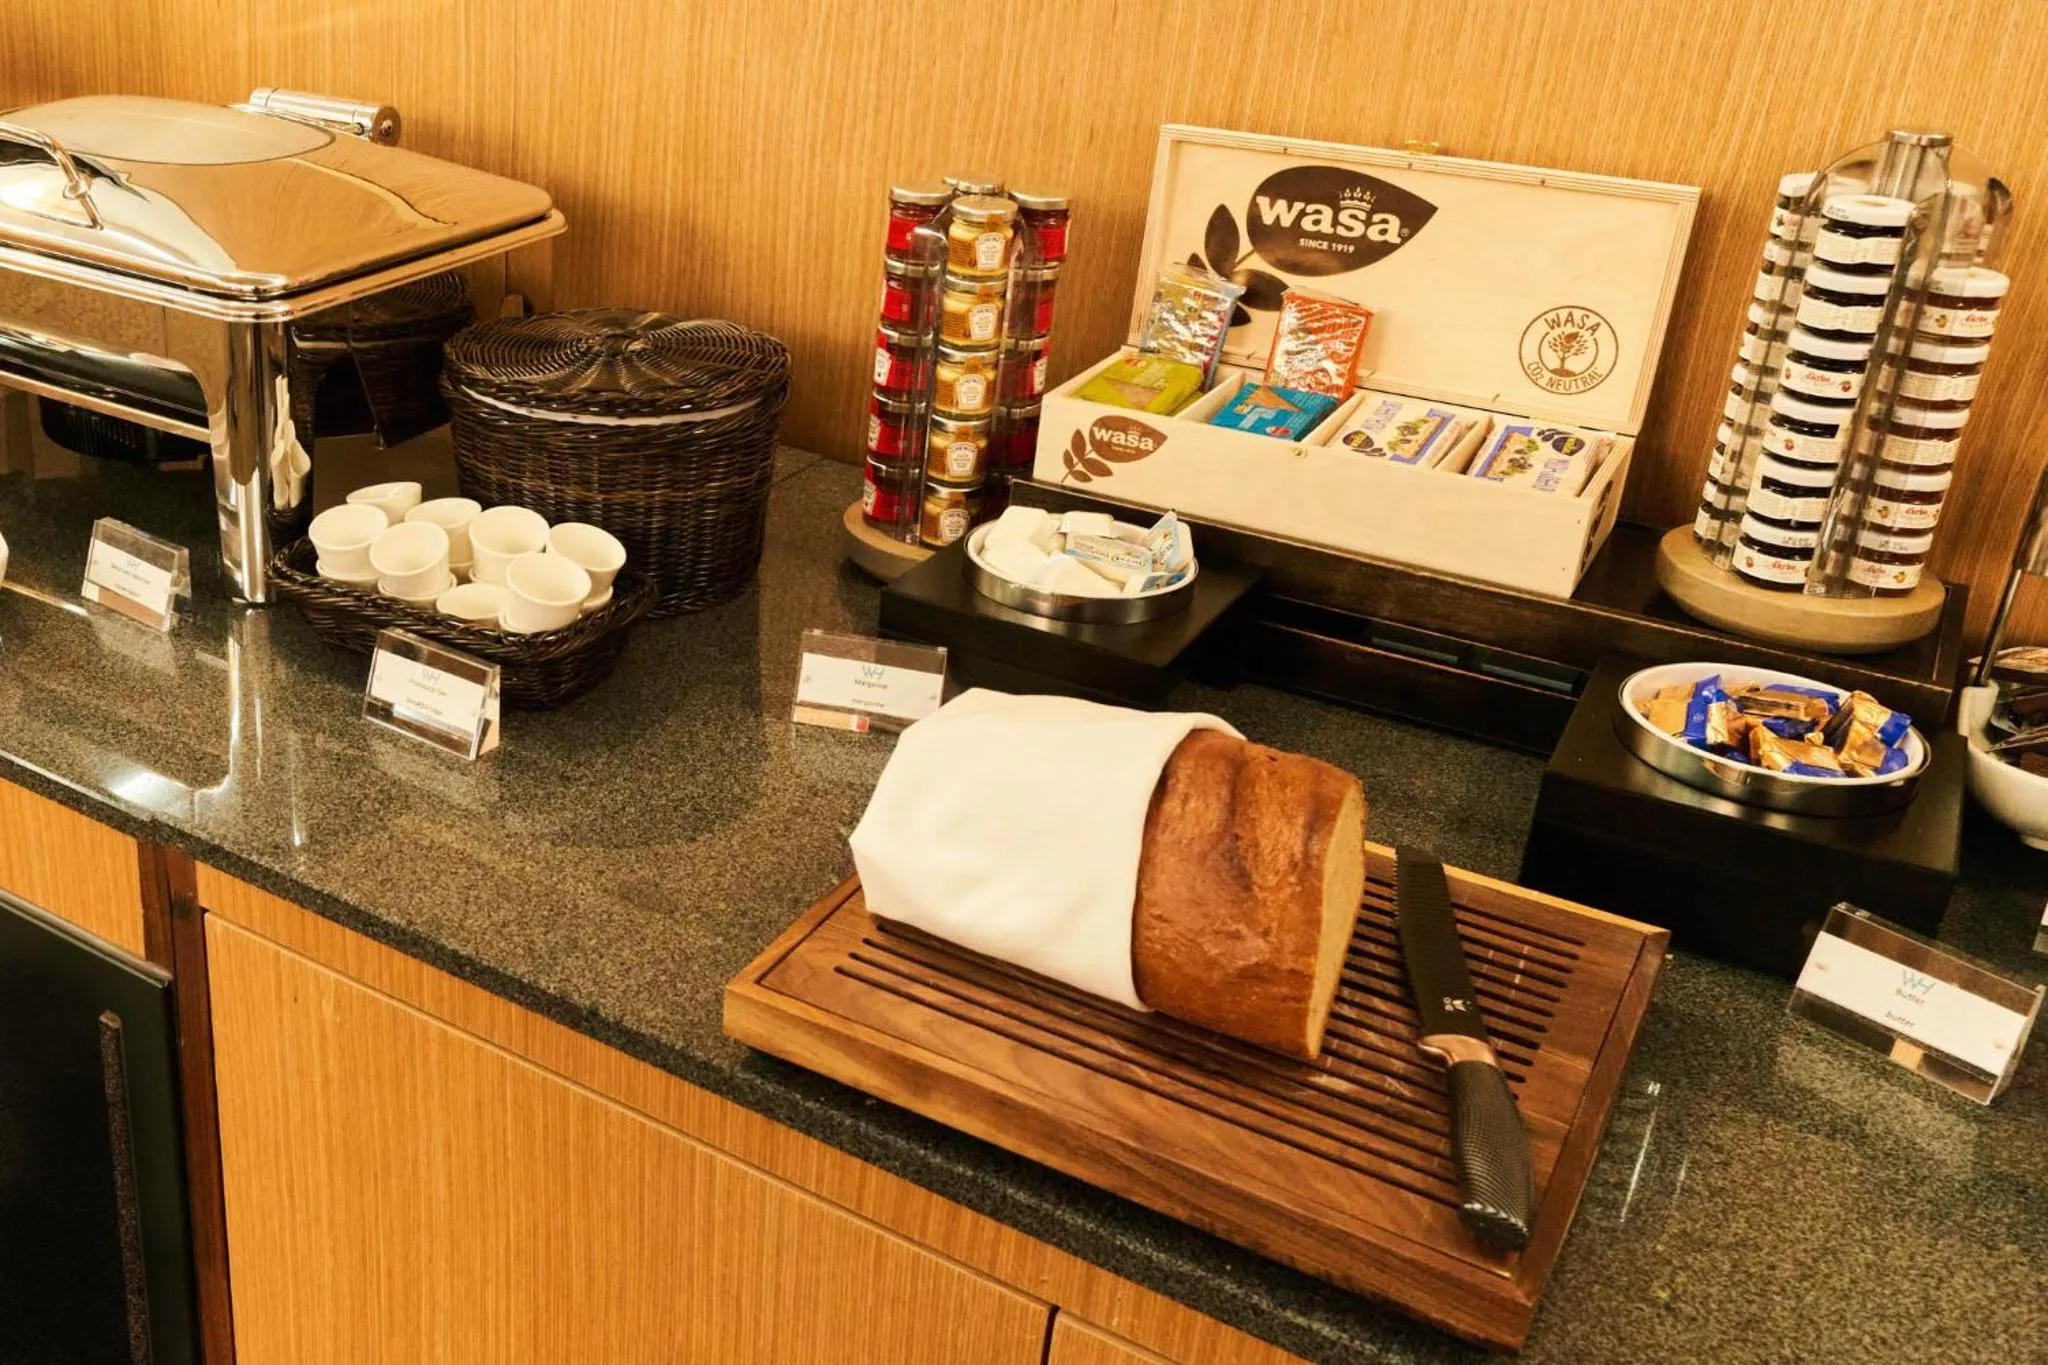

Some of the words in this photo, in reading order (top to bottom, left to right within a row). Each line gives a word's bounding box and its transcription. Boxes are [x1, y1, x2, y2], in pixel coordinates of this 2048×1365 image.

[1256, 194, 1404, 245] wasa
[1298, 238, 1329, 251] SINCE
[1330, 241, 1355, 254] 1919
[1544, 310, 1601, 338] WASA
[1544, 366, 1604, 391] NEUTRAL
[1092, 426, 1155, 452] wasa
